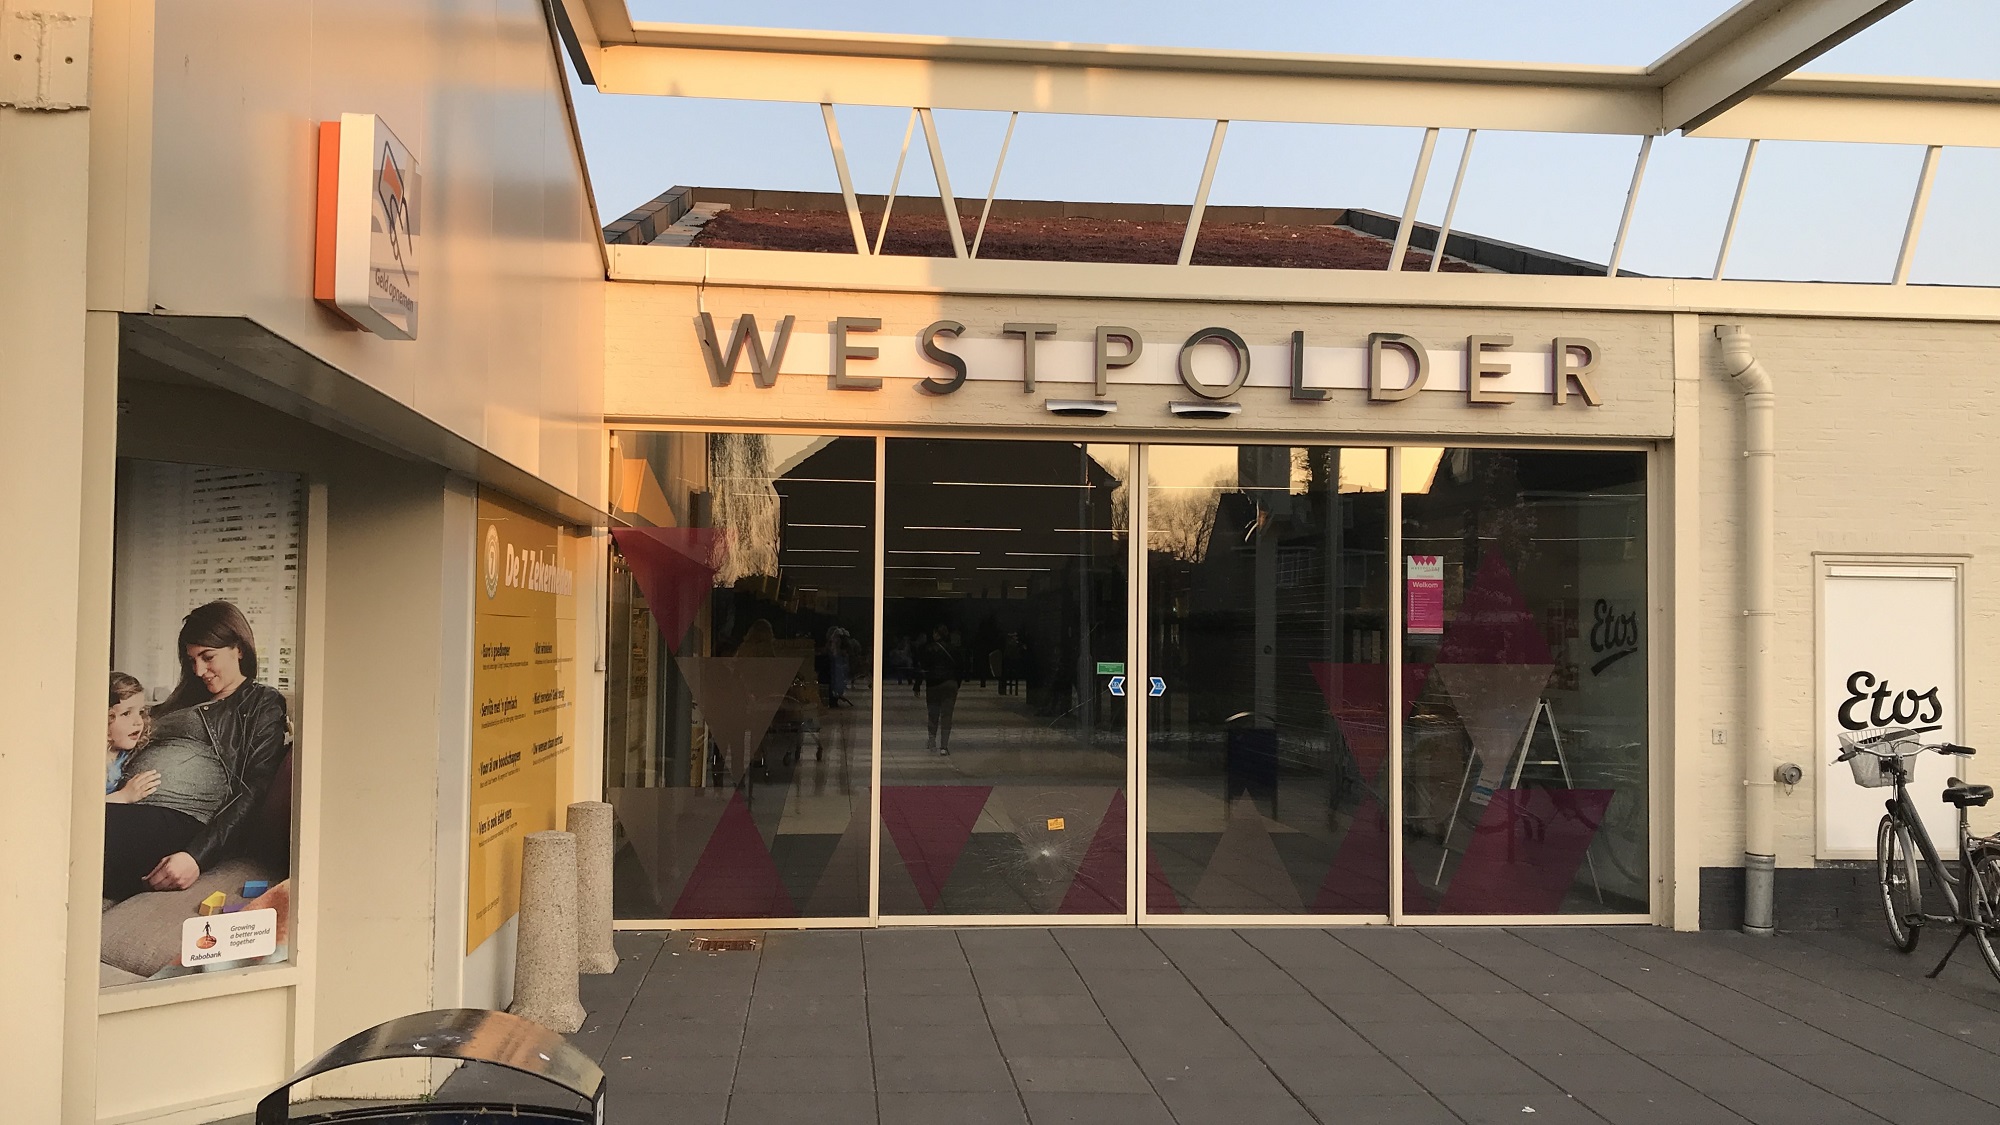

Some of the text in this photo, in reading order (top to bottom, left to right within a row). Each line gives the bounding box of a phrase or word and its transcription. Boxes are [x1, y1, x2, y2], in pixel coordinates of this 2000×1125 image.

[375, 268, 413, 312] Geld opnemen
[699, 312, 1603, 407] WESTPOLDER
[505, 543, 573, 596] De 7 Zekerheden
[1412, 581, 1439, 589] Welkom
[1590, 598, 1638, 653] Etos
[1837, 670, 1943, 731] Etos
[230, 924, 255, 932] Growing
[254, 928, 270, 936] world
[190, 951, 222, 961] Rabobank
[230, 938, 255, 947] together
